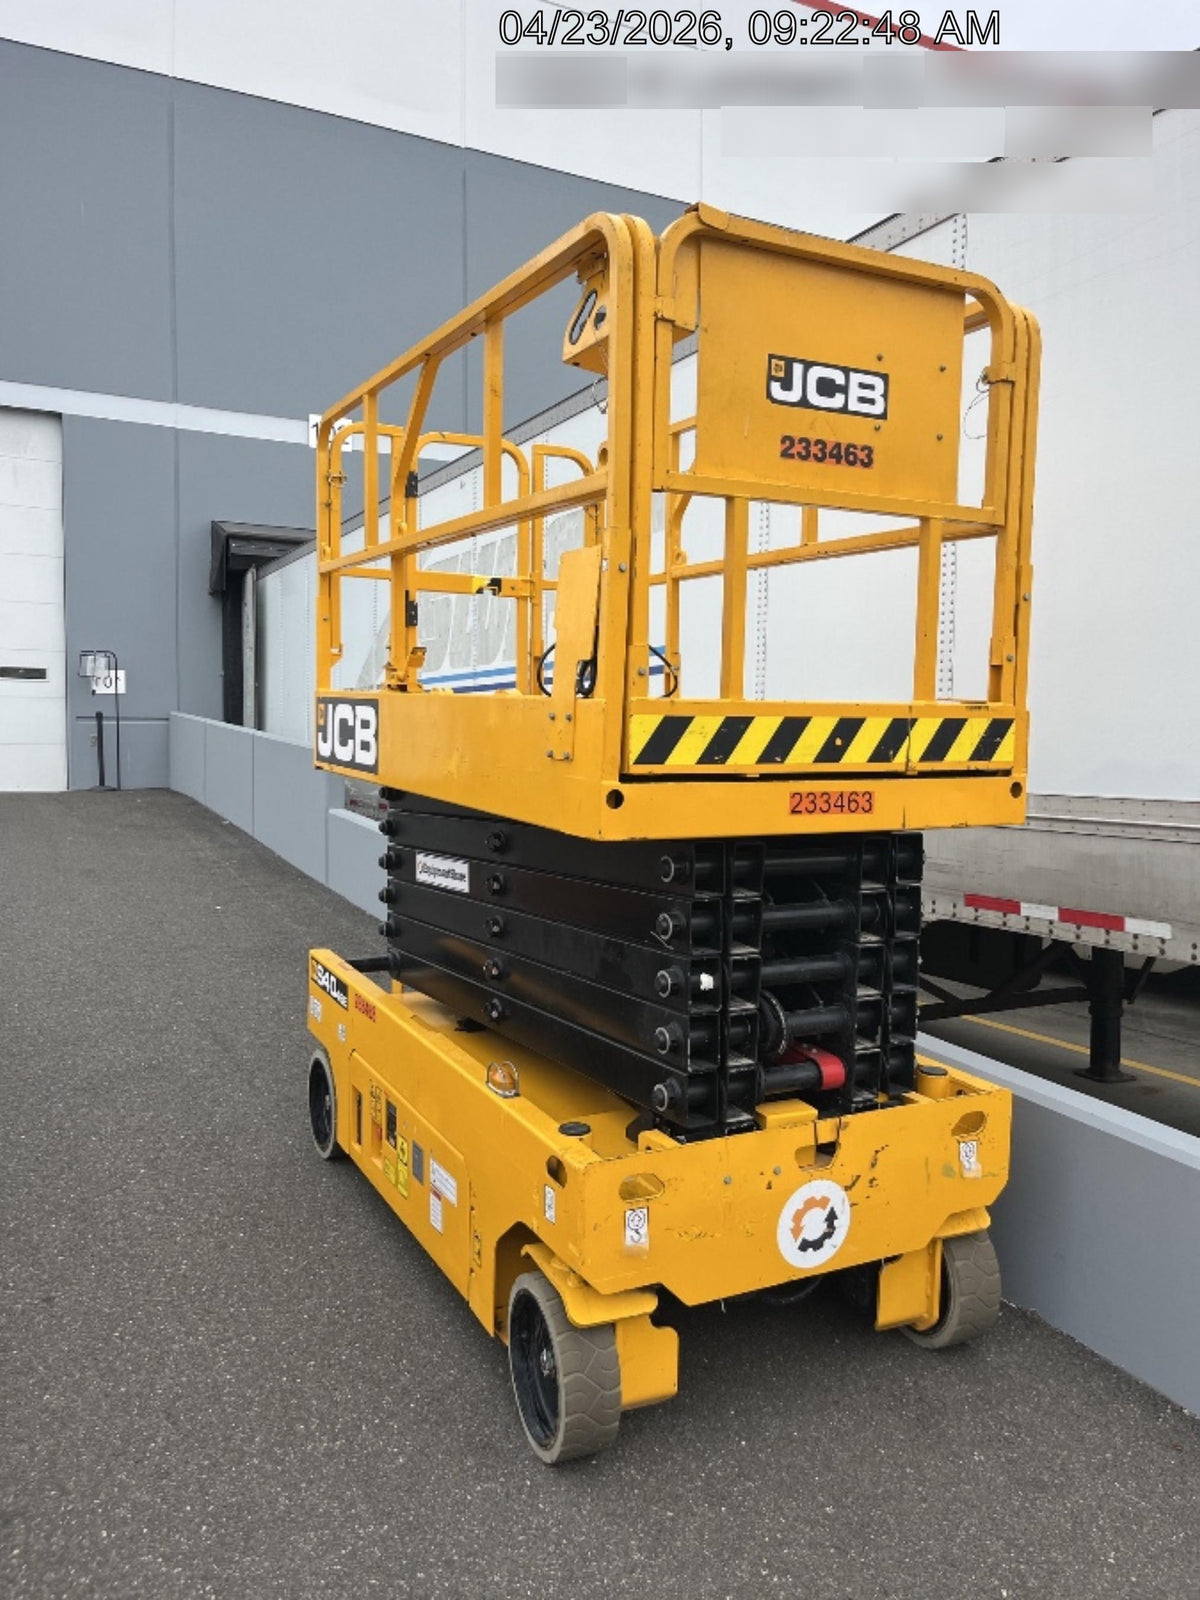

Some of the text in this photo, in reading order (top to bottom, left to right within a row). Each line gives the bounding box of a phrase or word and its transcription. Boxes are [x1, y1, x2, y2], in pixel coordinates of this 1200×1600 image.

[770, 362, 886, 415] JCB
[779, 435, 874, 468] 233463
[317, 703, 377, 766] JCB
[790, 791, 873, 814] 233463
